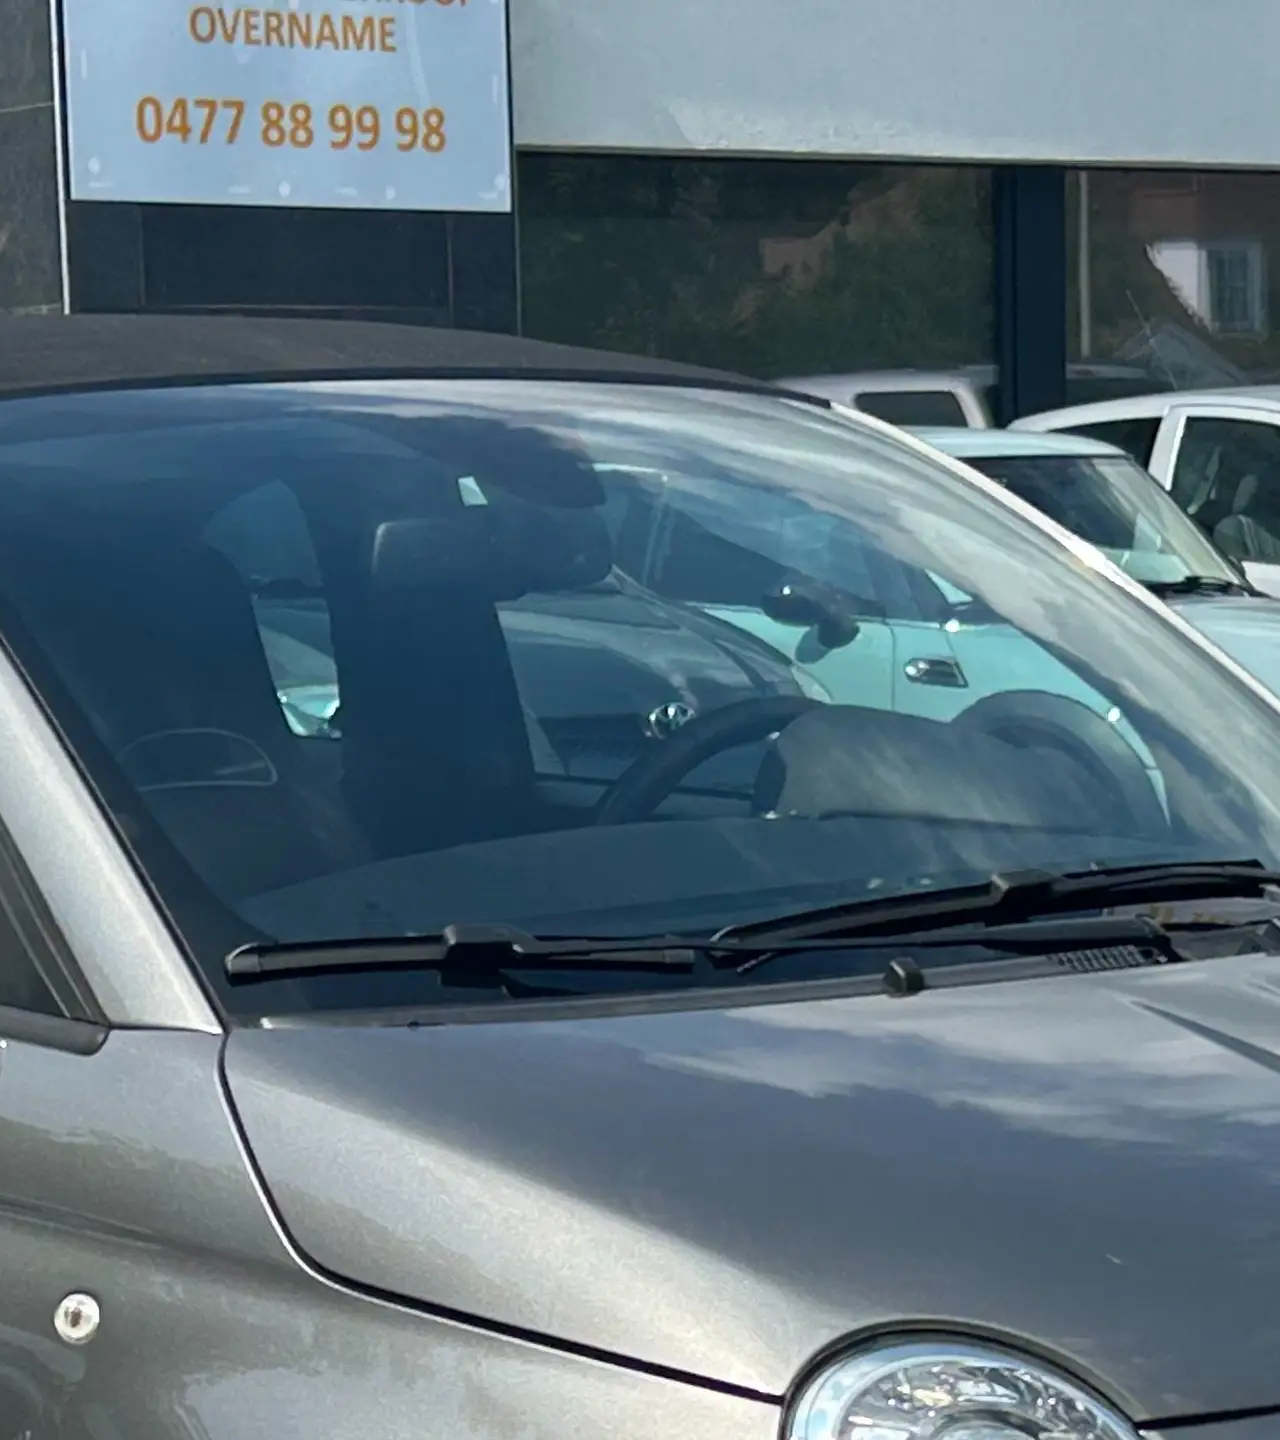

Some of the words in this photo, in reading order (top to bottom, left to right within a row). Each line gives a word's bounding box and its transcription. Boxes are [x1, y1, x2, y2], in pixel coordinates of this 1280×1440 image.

[189, 7, 397, 53] OVERNAME
[136, 96, 245, 144] 0477
[261, 102, 314, 149] 88
[328, 105, 380, 151] 99
[395, 107, 447, 153] 98
